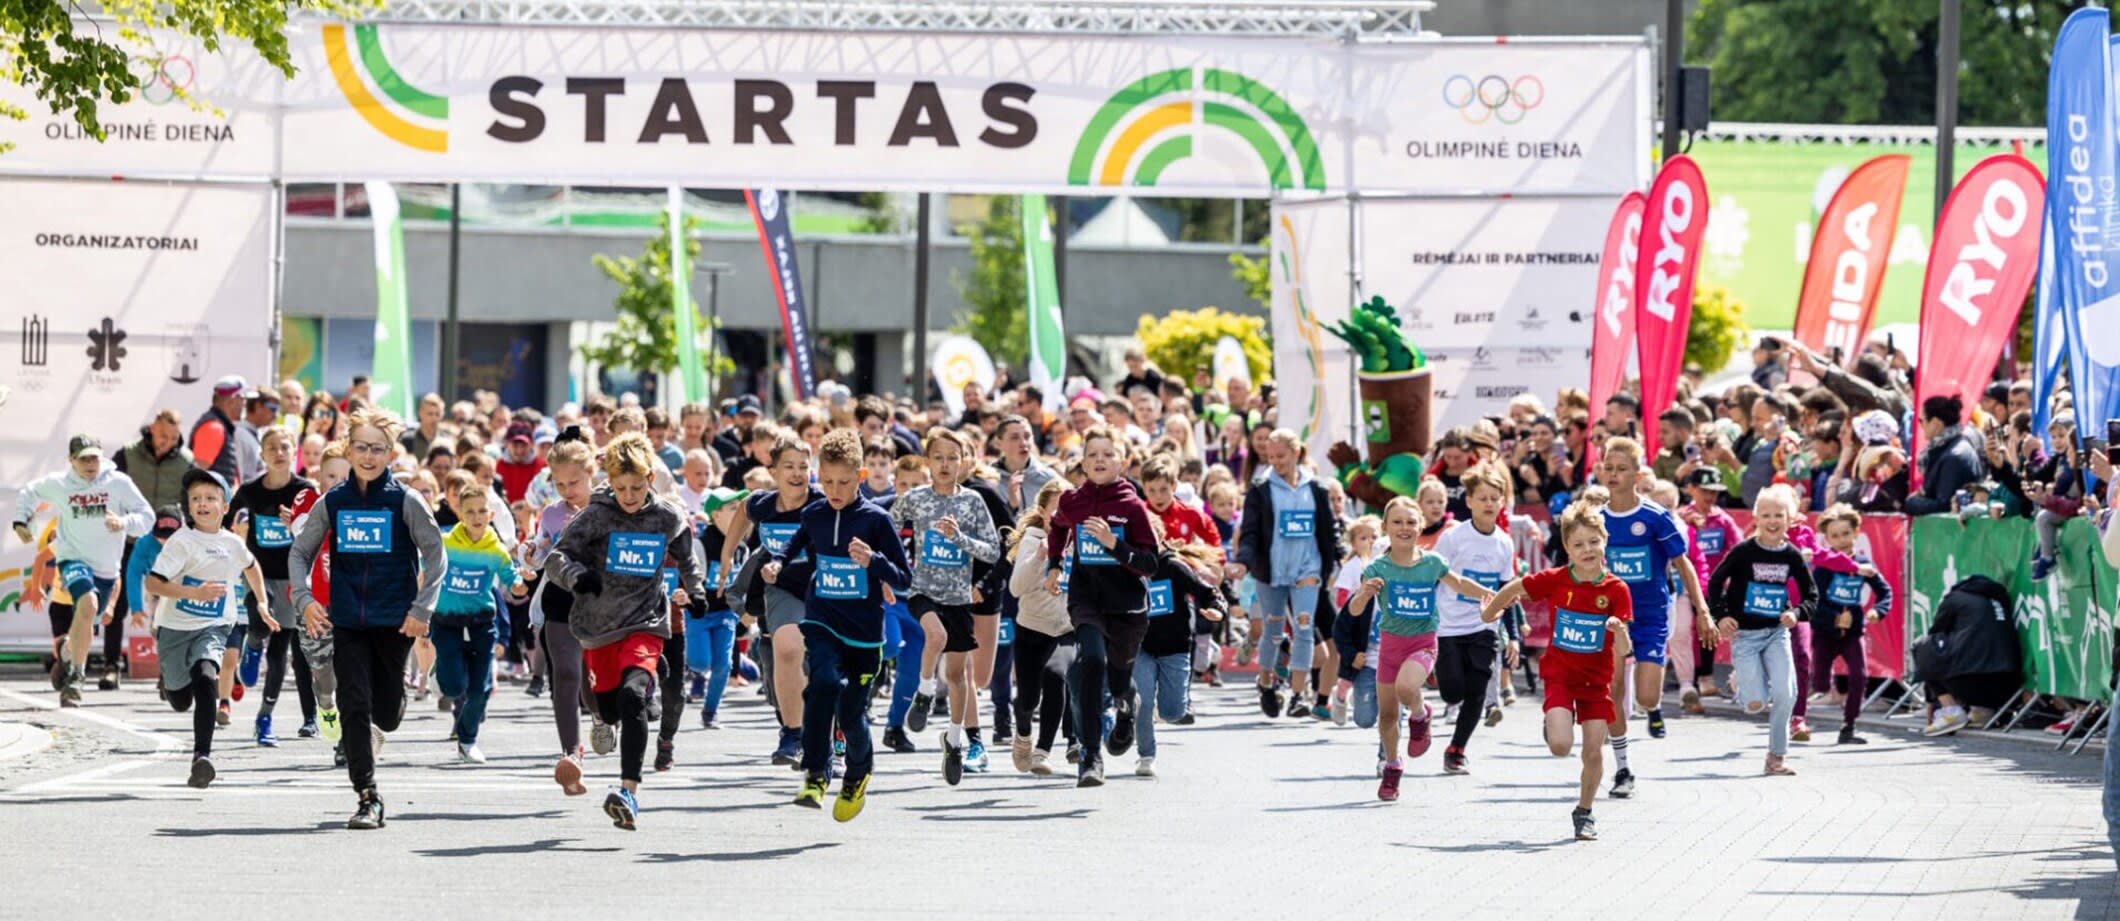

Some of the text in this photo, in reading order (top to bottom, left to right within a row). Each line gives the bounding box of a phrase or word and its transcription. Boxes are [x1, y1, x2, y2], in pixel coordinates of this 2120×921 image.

[485, 75, 1039, 149] STARTAS
[45, 119, 235, 141] OLIPINĖ DIENA
[1406, 136, 1583, 159] OLIMPINĖ DIENA
[2065, 114, 2109, 288] affidea
[35, 233, 199, 251] ORGANIZATORIAI
[1413, 250, 1600, 265] RĖMĖJAI IR PARTNERIAI
[1645, 180, 1693, 323] RYO
[1940, 178, 2028, 327] RYO
[1287, 521, 1311, 532] Nr. 1
[347, 528, 380, 541] Nr. 1
[767, 537, 783, 549] Nr
[1081, 541, 1104, 554] Nr.
[619, 551, 655, 564] Nr. 1
[932, 545, 963, 559] Nr. 1
[1613, 561, 1642, 573] Nr. 1
[452, 577, 480, 589] Nr. 1
[822, 573, 856, 587] Nr. 1
[1397, 597, 1428, 609] Nr. 1
[1753, 597, 1781, 609] Nr. 1
[1562, 626, 1598, 643] Nr. 1
